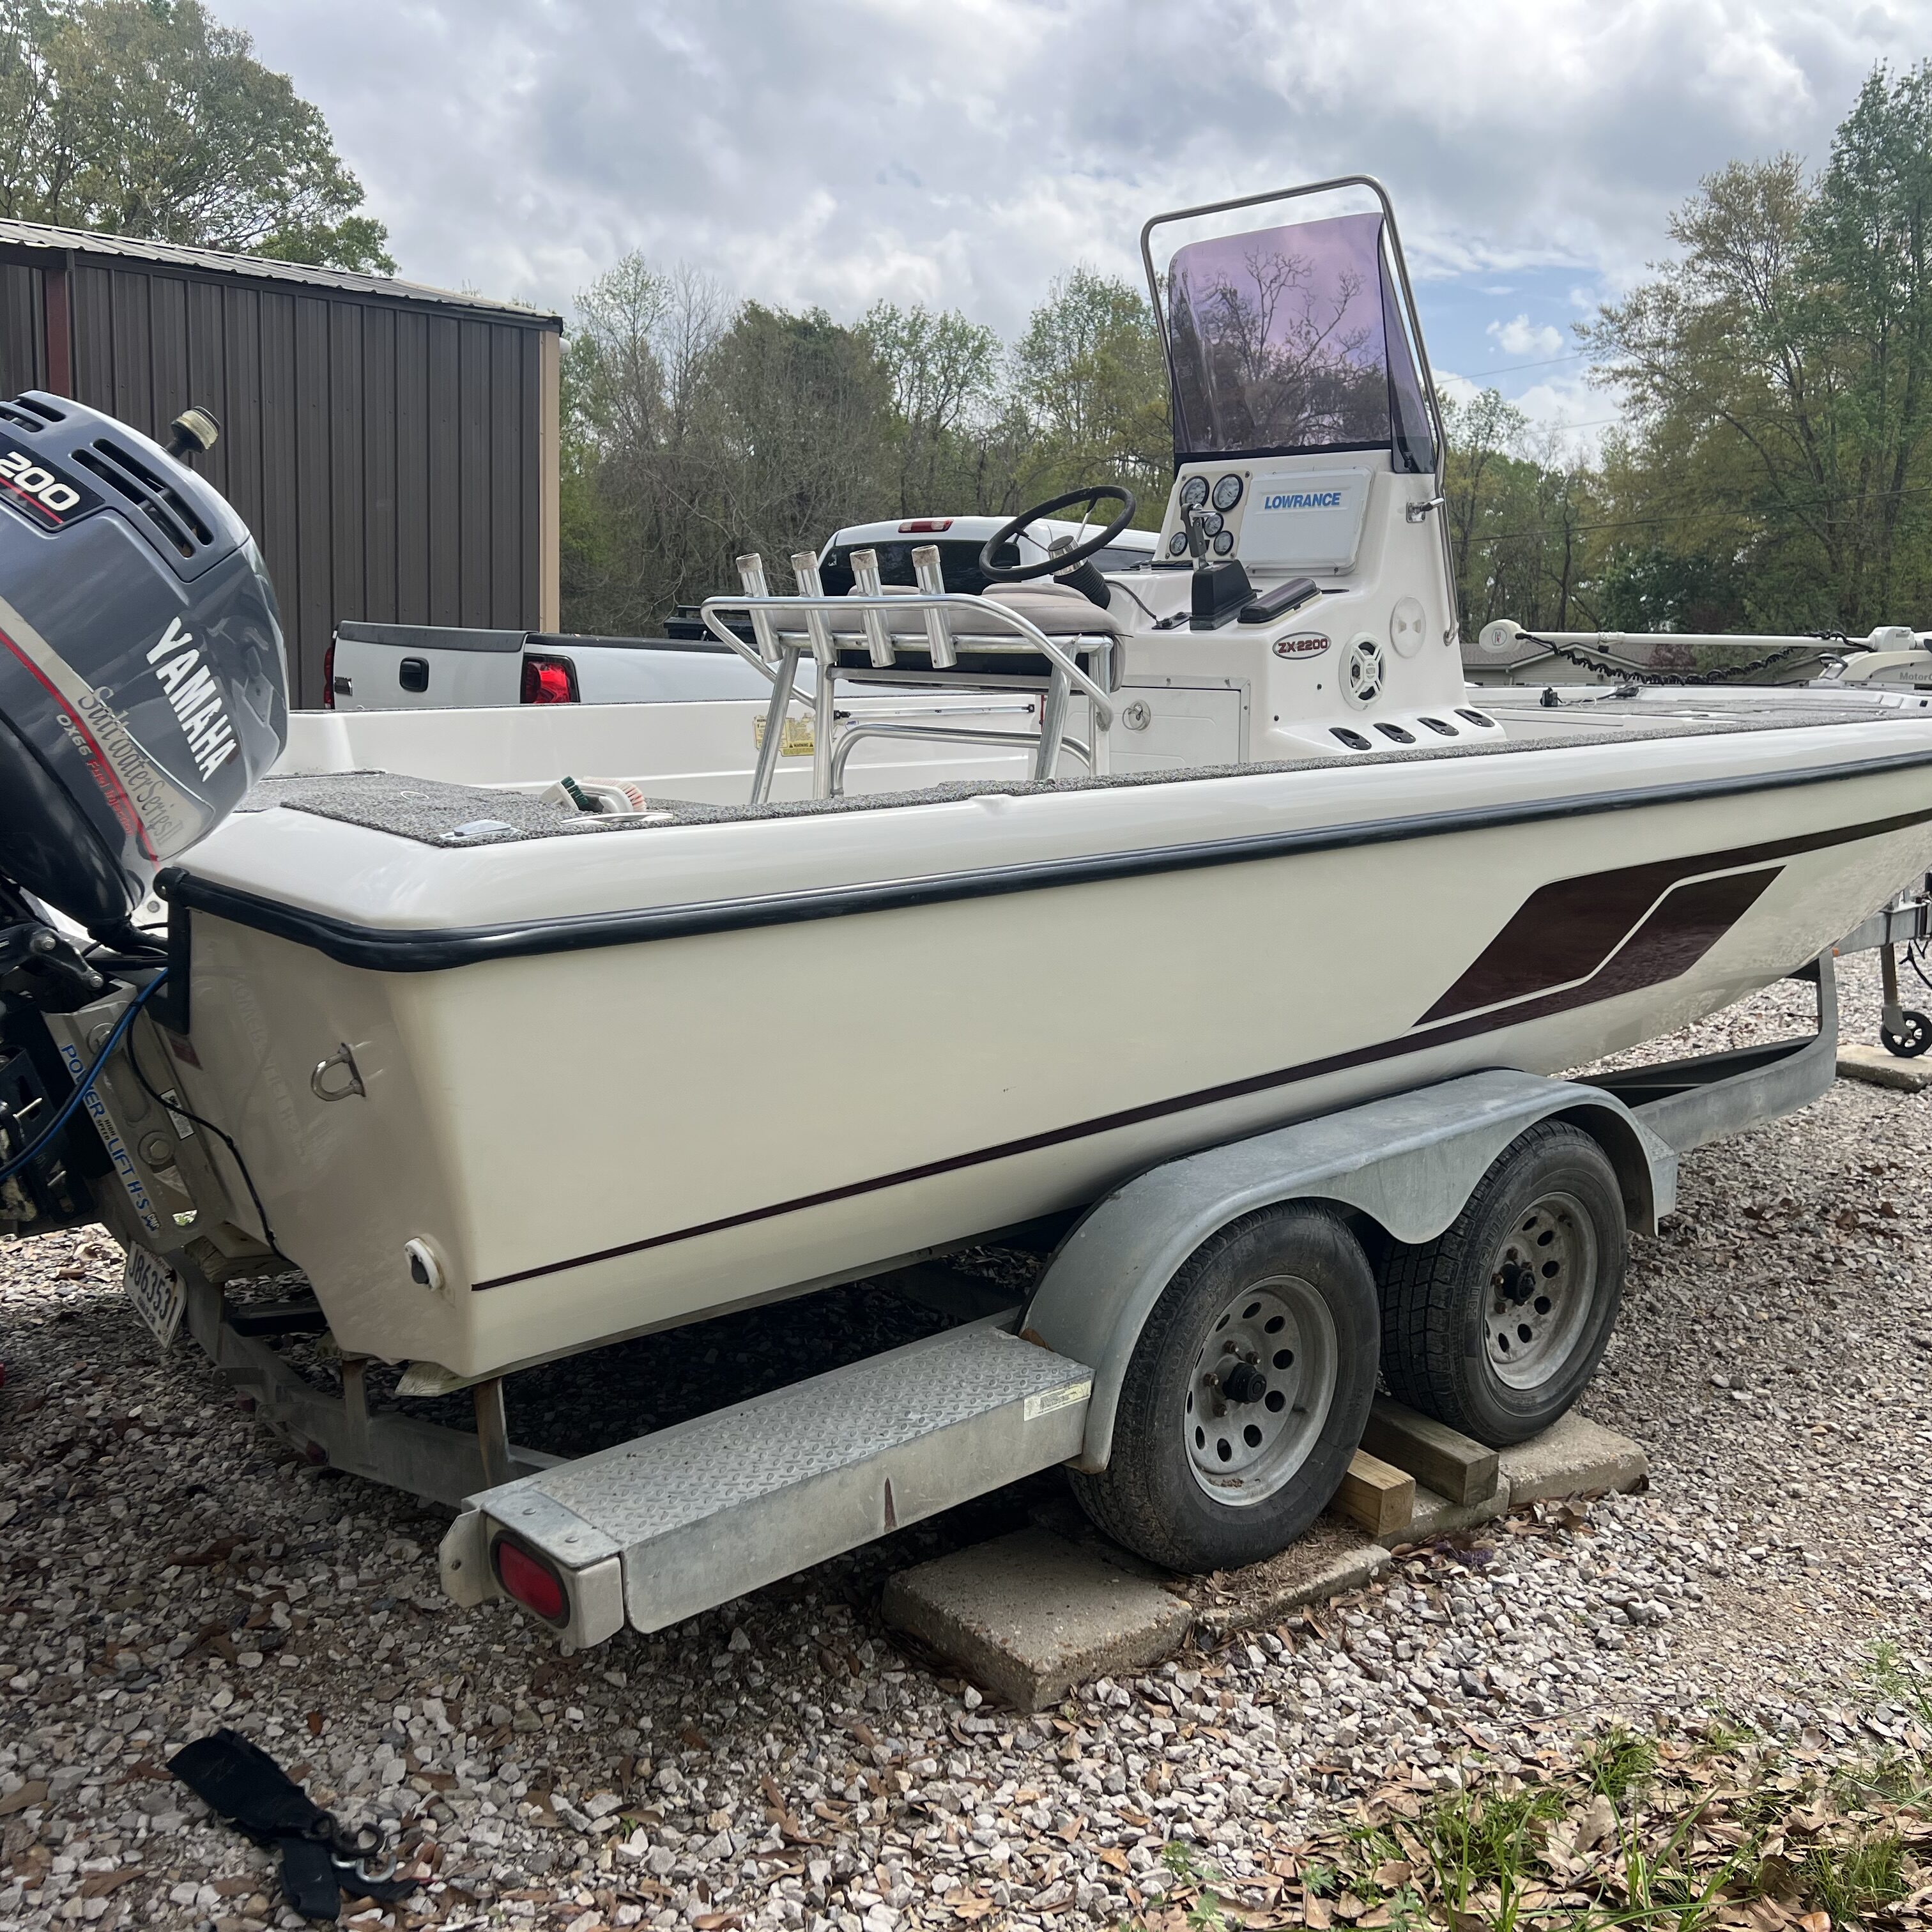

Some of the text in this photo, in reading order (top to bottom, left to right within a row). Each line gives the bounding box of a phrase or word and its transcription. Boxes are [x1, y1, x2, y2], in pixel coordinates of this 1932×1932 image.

[0, 451, 80, 511] 200
[1264, 493, 1341, 509] LOWRANCE
[146, 616, 237, 783] YAMAHA
[56, 714, 93, 756] OX66
[108, 1137, 135, 1176] LIFT
[128, 1181, 149, 1209] H-S
[128, 1249, 177, 1328] J863531
